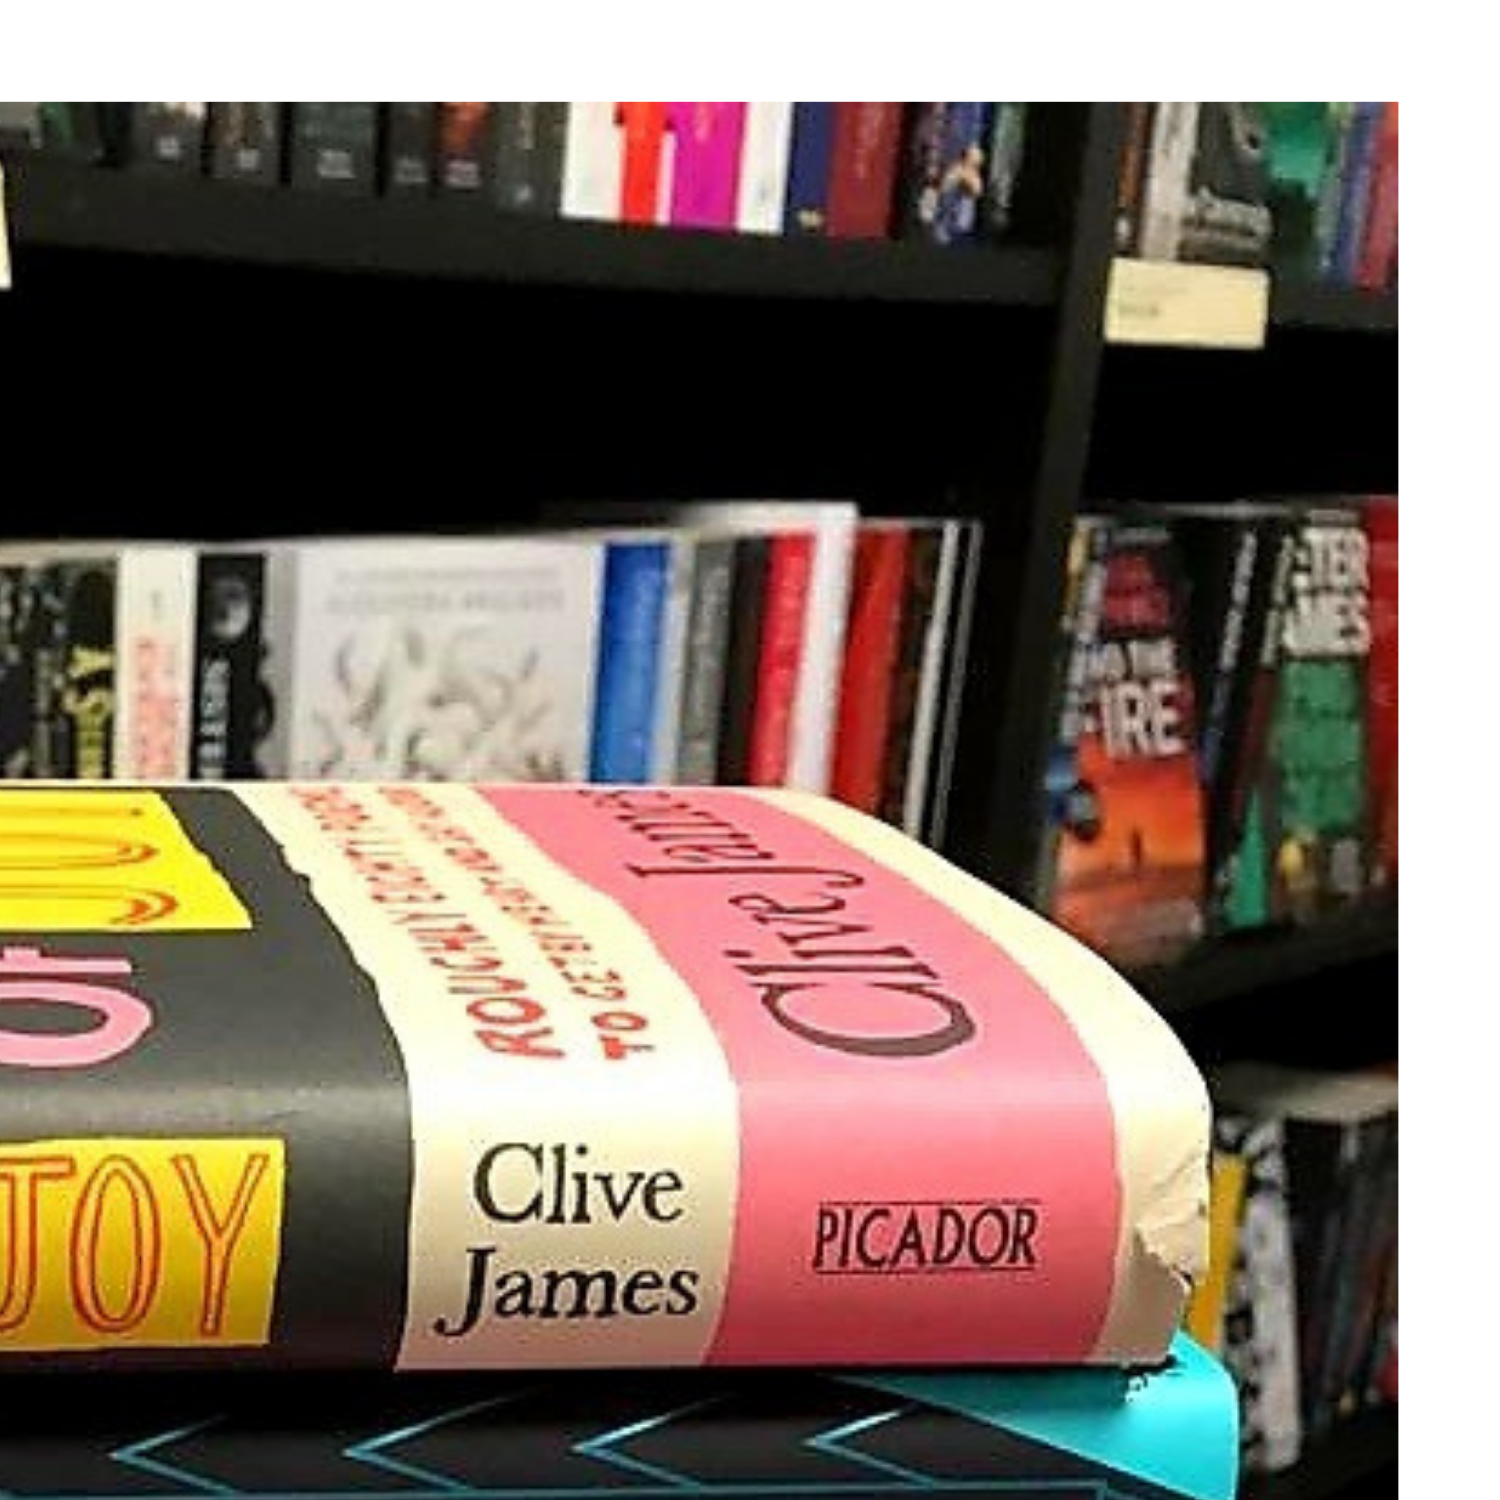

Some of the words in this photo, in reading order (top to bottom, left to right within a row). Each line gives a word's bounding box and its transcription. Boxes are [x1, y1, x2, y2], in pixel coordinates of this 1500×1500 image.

[722, 893, 977, 1058] Clive
[591, 1010, 655, 1060] TO
[471, 1141, 685, 1226] Clive
[812, 1205, 1040, 1269] PICADOR
[433, 1245, 700, 1338] James
